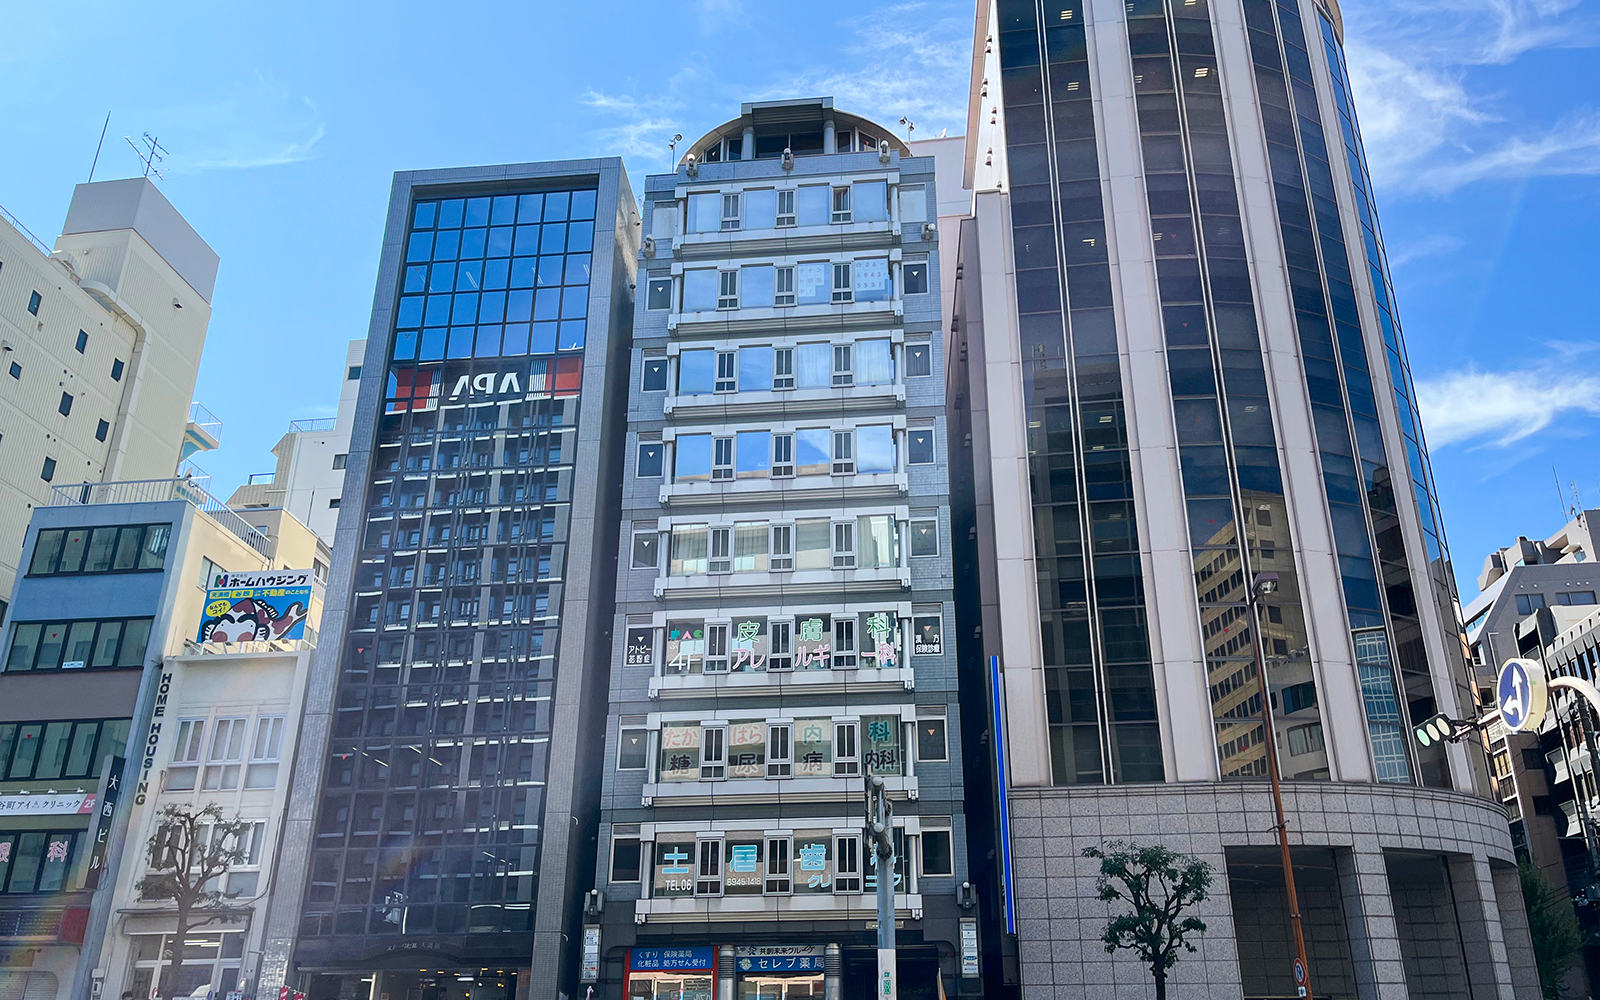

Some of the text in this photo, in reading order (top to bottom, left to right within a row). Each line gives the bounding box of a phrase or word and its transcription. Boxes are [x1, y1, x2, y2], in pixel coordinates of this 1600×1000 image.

[230, 575, 309, 587] ホームハウジング
[210, 602, 227, 610] なんでも
[628, 645, 652, 654] アトピー
[628, 655, 651, 664] 花粉症
[154, 673, 172, 717] HOME
[135, 723, 161, 806] HOUSING
[42, 799, 81, 810] クリニック
[84, 799, 96, 809] 2F
[90, 774, 119, 869] 大西ビル
[665, 880, 680, 891] TEL
[681, 879, 692, 891] 06
[638, 950, 692, 959] くすり 保険薬局
[637, 959, 706, 968] 化粧品 処方せん受付
[758, 957, 824, 969] セレブ薬局
